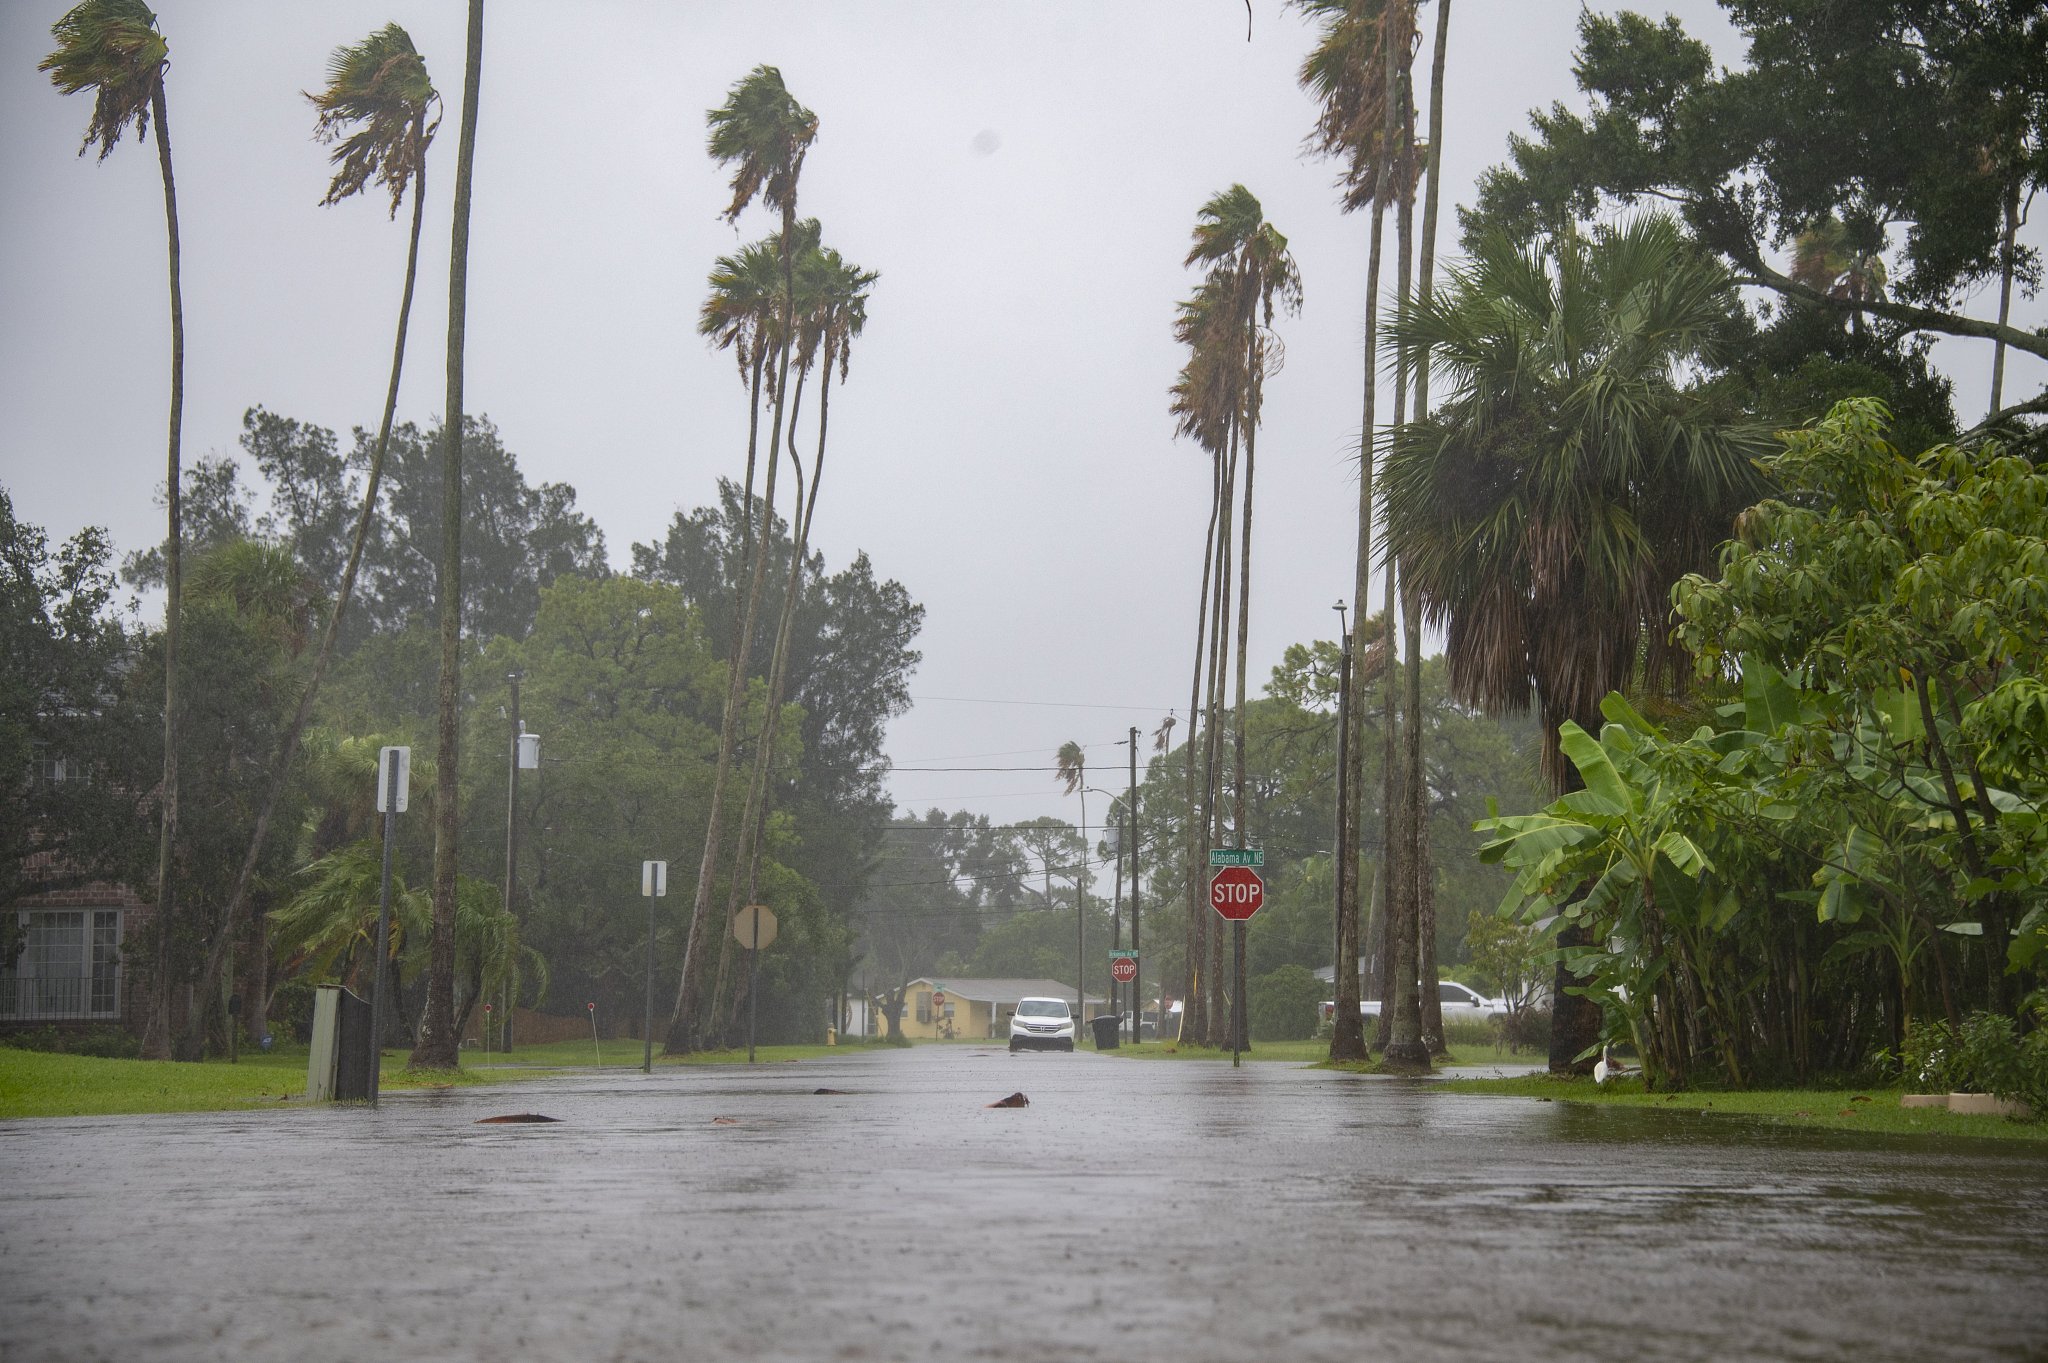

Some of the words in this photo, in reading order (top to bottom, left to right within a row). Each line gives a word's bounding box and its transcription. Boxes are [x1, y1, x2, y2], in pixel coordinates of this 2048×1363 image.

[1211, 851, 1239, 863] Alabama
[1242, 851, 1251, 863] Av
[1254, 851, 1263, 863] NE
[1214, 883, 1260, 903] STOP
[1114, 965, 1134, 974] STOP
